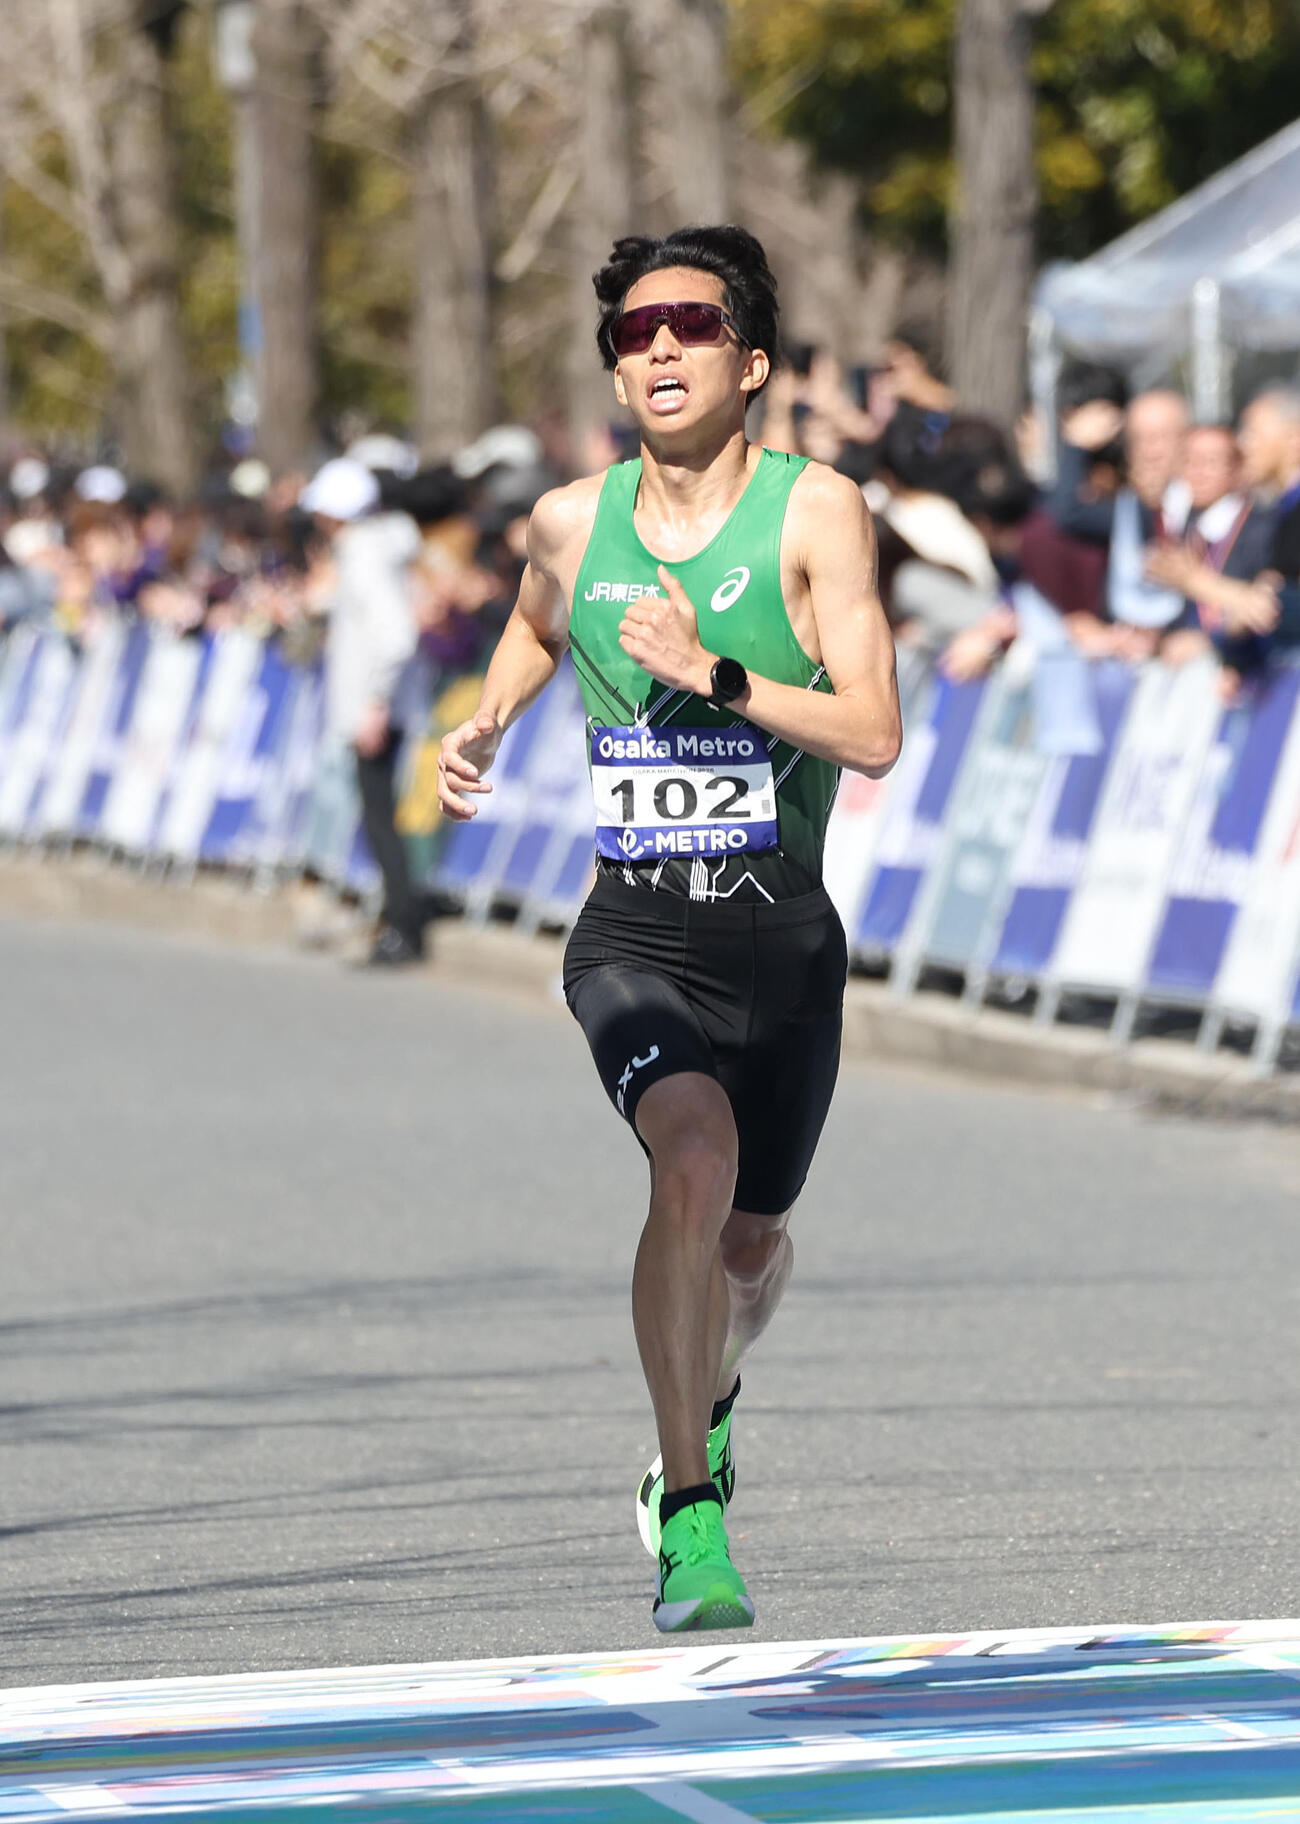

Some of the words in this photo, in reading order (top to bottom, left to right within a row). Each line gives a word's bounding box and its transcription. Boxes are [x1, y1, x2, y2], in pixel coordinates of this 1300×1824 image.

[584, 581, 660, 603] JR東日本
[599, 735, 671, 759] Osaka
[677, 735, 754, 757] Metro
[610, 775, 751, 823] 102
